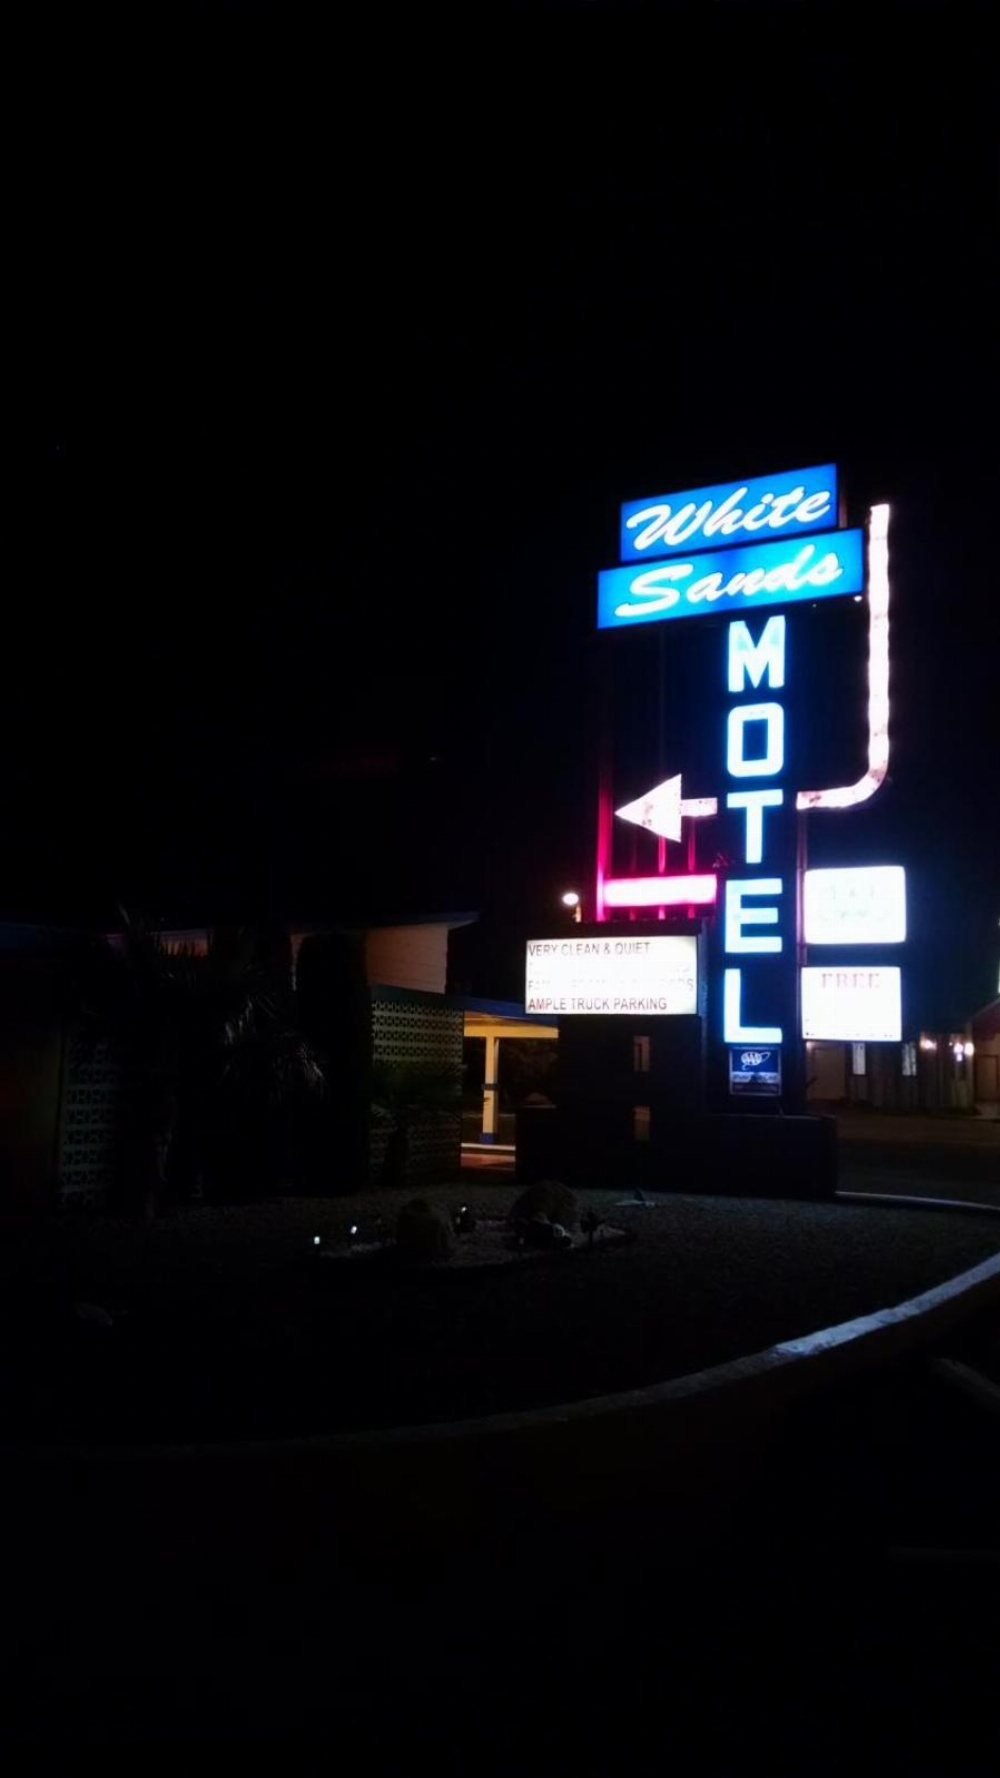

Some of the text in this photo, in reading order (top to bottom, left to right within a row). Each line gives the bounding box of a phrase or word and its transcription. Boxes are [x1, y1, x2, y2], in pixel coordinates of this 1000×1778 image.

[626, 486, 830, 550] White
[614, 544, 843, 617] Sands
[723, 615, 786, 1044] MOTEL
[527, 941, 651, 957] VERY CLEAN & QUIET
[527, 997, 668, 1011] AMPLE TRUCK PARKING
